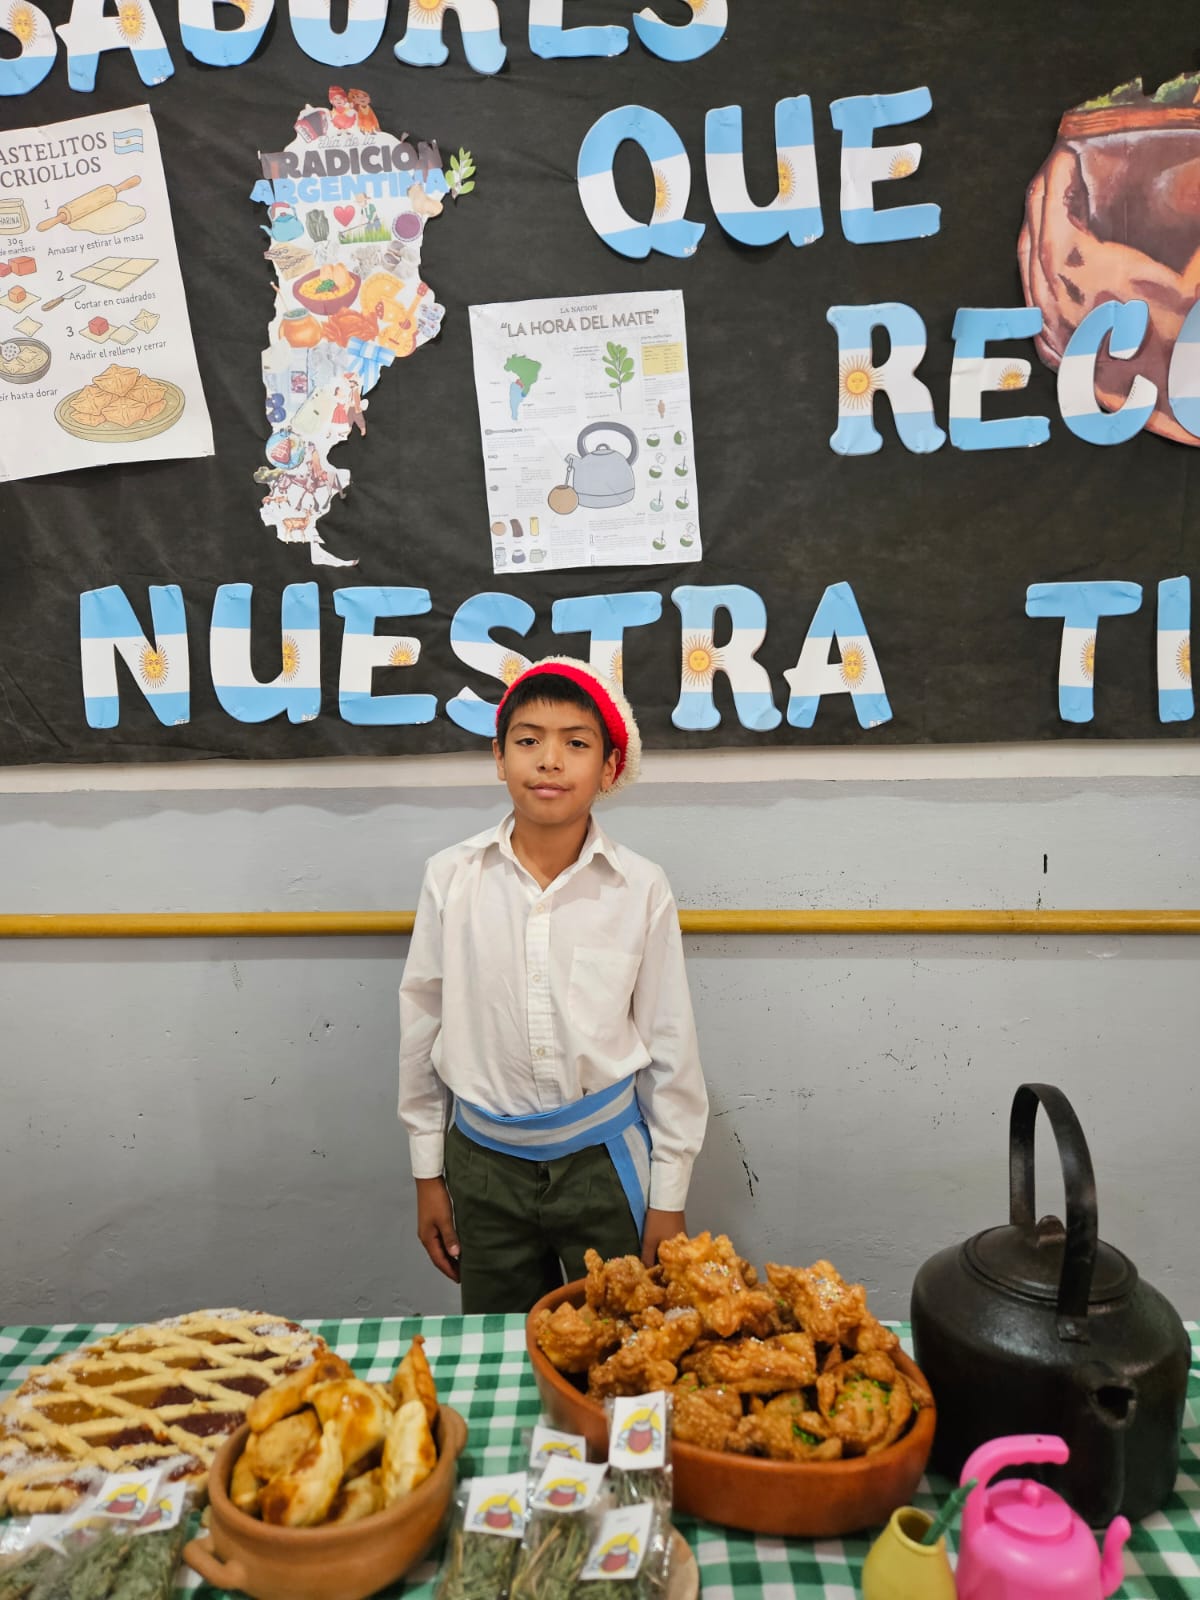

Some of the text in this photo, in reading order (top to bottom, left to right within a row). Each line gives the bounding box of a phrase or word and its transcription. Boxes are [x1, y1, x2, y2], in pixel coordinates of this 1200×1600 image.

[0, 157, 101, 188] CRIOLLOS
[577, 86, 941, 259] QUE
[249, 168, 449, 206] ARGENTINA
[44, 199, 50, 209] 1
[48, 233, 144, 256] Amasar y estirar la masa
[56, 270, 64, 281] 2
[74, 292, 156, 310] Cortar en cuadrados
[66, 326, 74, 337] 3
[531, 317, 577, 336] HORA
[580, 313, 609, 331] DEL
[69, 341, 167, 361] Añadir el relleno y cerrar
[10, 391, 34, 401] hasta
[36, 388, 58, 398] dorar
[80, 580, 893, 737] NUESTRA
[1025, 575, 1195, 724] TI
